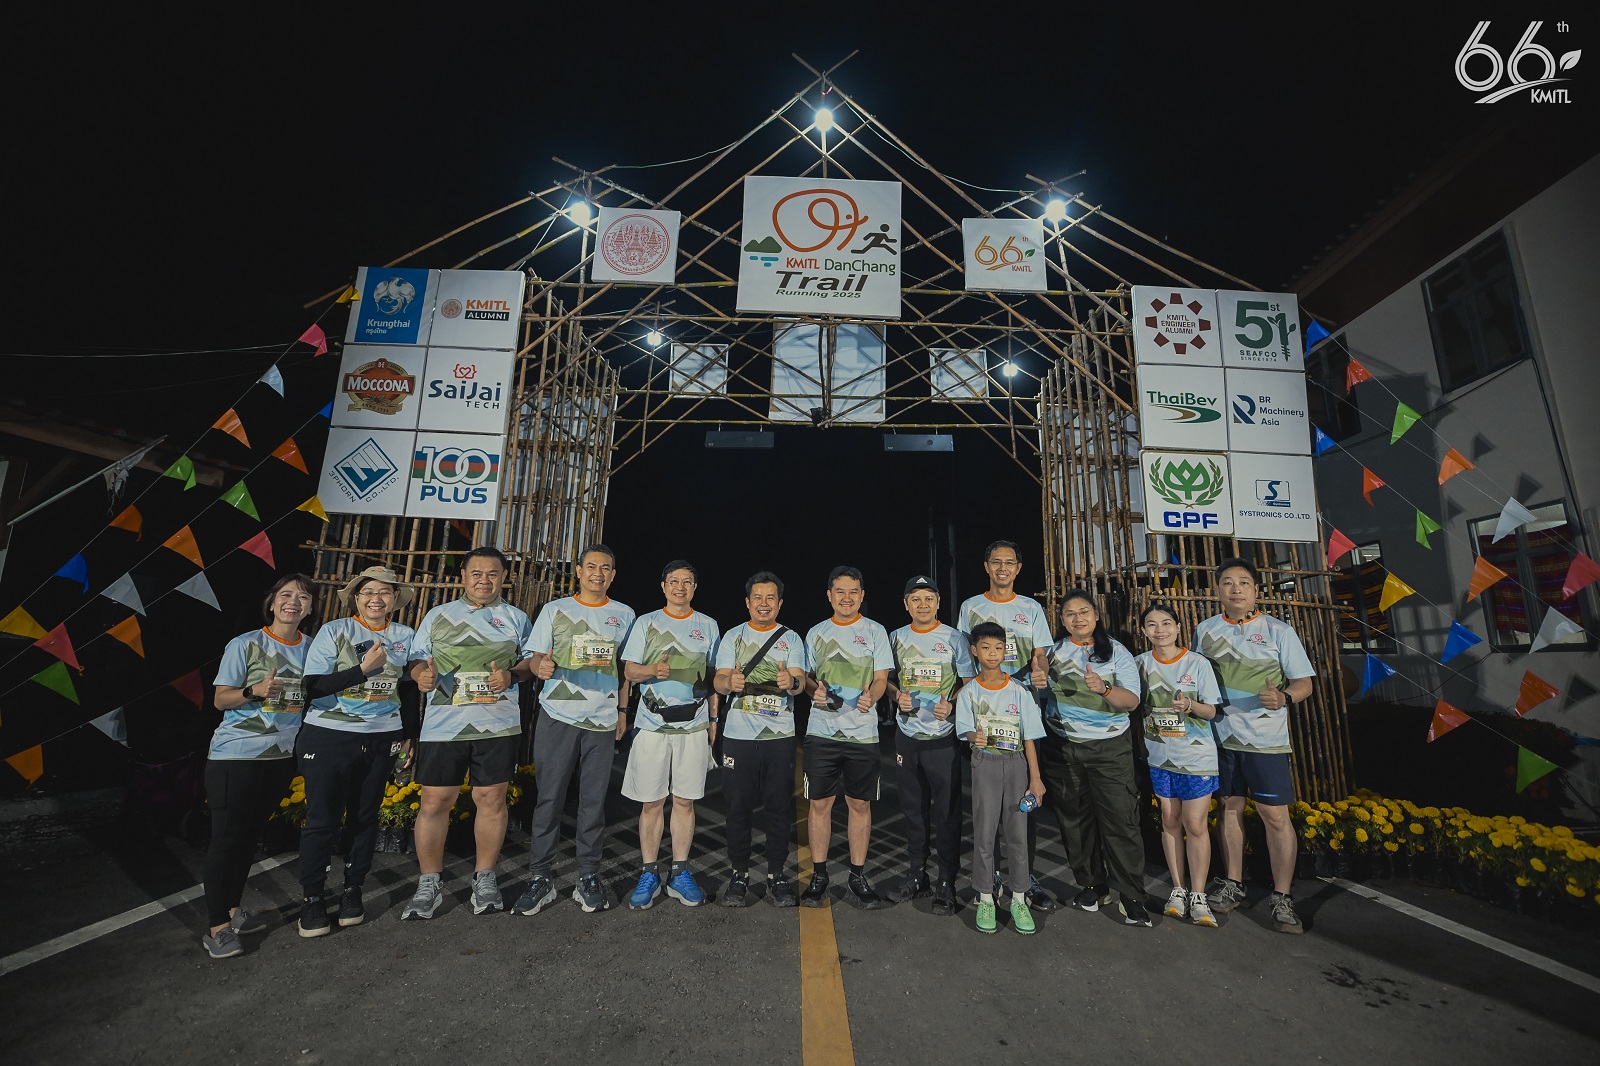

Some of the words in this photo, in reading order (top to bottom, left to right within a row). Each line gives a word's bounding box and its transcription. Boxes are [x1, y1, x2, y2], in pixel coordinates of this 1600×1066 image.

[786, 257, 820, 269] KMITL
[824, 259, 896, 276] DanChang
[776, 270, 868, 292] Trail
[776, 289, 828, 298] Running
[466, 299, 511, 311] KMITL
[1166, 314, 1189, 322] KMITL
[367, 318, 410, 330] Krungthai
[1161, 320, 1196, 328] ENGINEER
[1165, 327, 1193, 335] ALUMNI
[1240, 350, 1277, 358] SEAFCO
[347, 376, 410, 393] MOCCONA
[428, 380, 501, 401] SaiJai
[1146, 391, 1217, 406] ThaiBev
[1259, 396, 1271, 404] BR
[465, 401, 499, 409] TECH
[1260, 407, 1304, 418] Machinery
[1261, 418, 1280, 426] Asia
[422, 446, 491, 485] 100
[328, 470, 357, 503] 3PHORN
[420, 485, 488, 504] PLUS
[1239, 510, 1282, 519] SYSTRONICS
[1163, 511, 1219, 529] CPF
[370, 681, 393, 689] 1503
[762, 696, 777, 705] 001
[995, 728, 1016, 738] 10121
